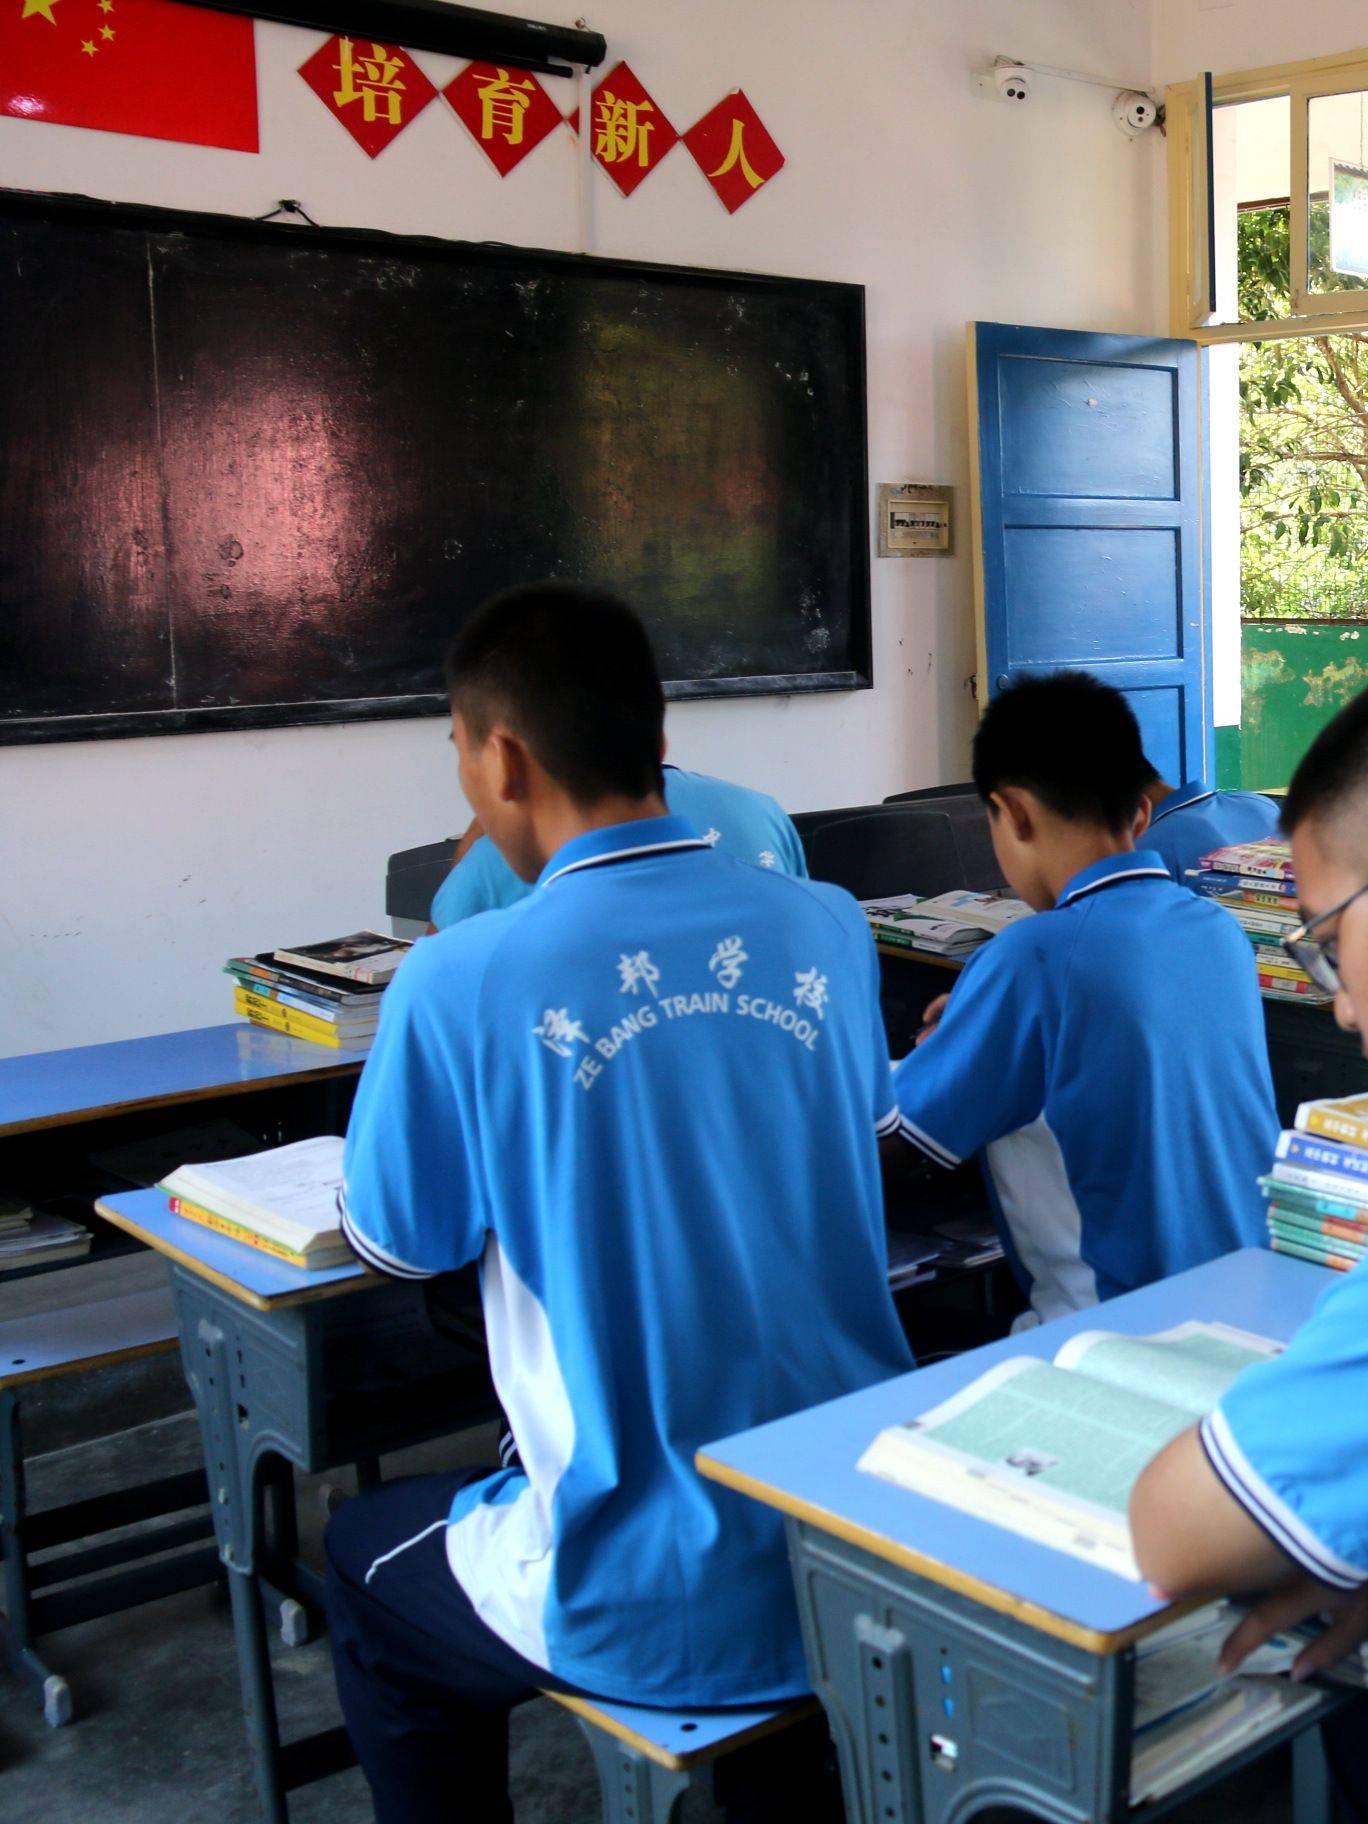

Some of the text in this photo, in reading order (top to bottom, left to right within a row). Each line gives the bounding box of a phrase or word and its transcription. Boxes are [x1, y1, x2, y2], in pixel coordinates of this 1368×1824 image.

[331, 37, 764, 189] 培育新人
[574, 992, 821, 1090] ZE BANG TRAIN SCHOOL
